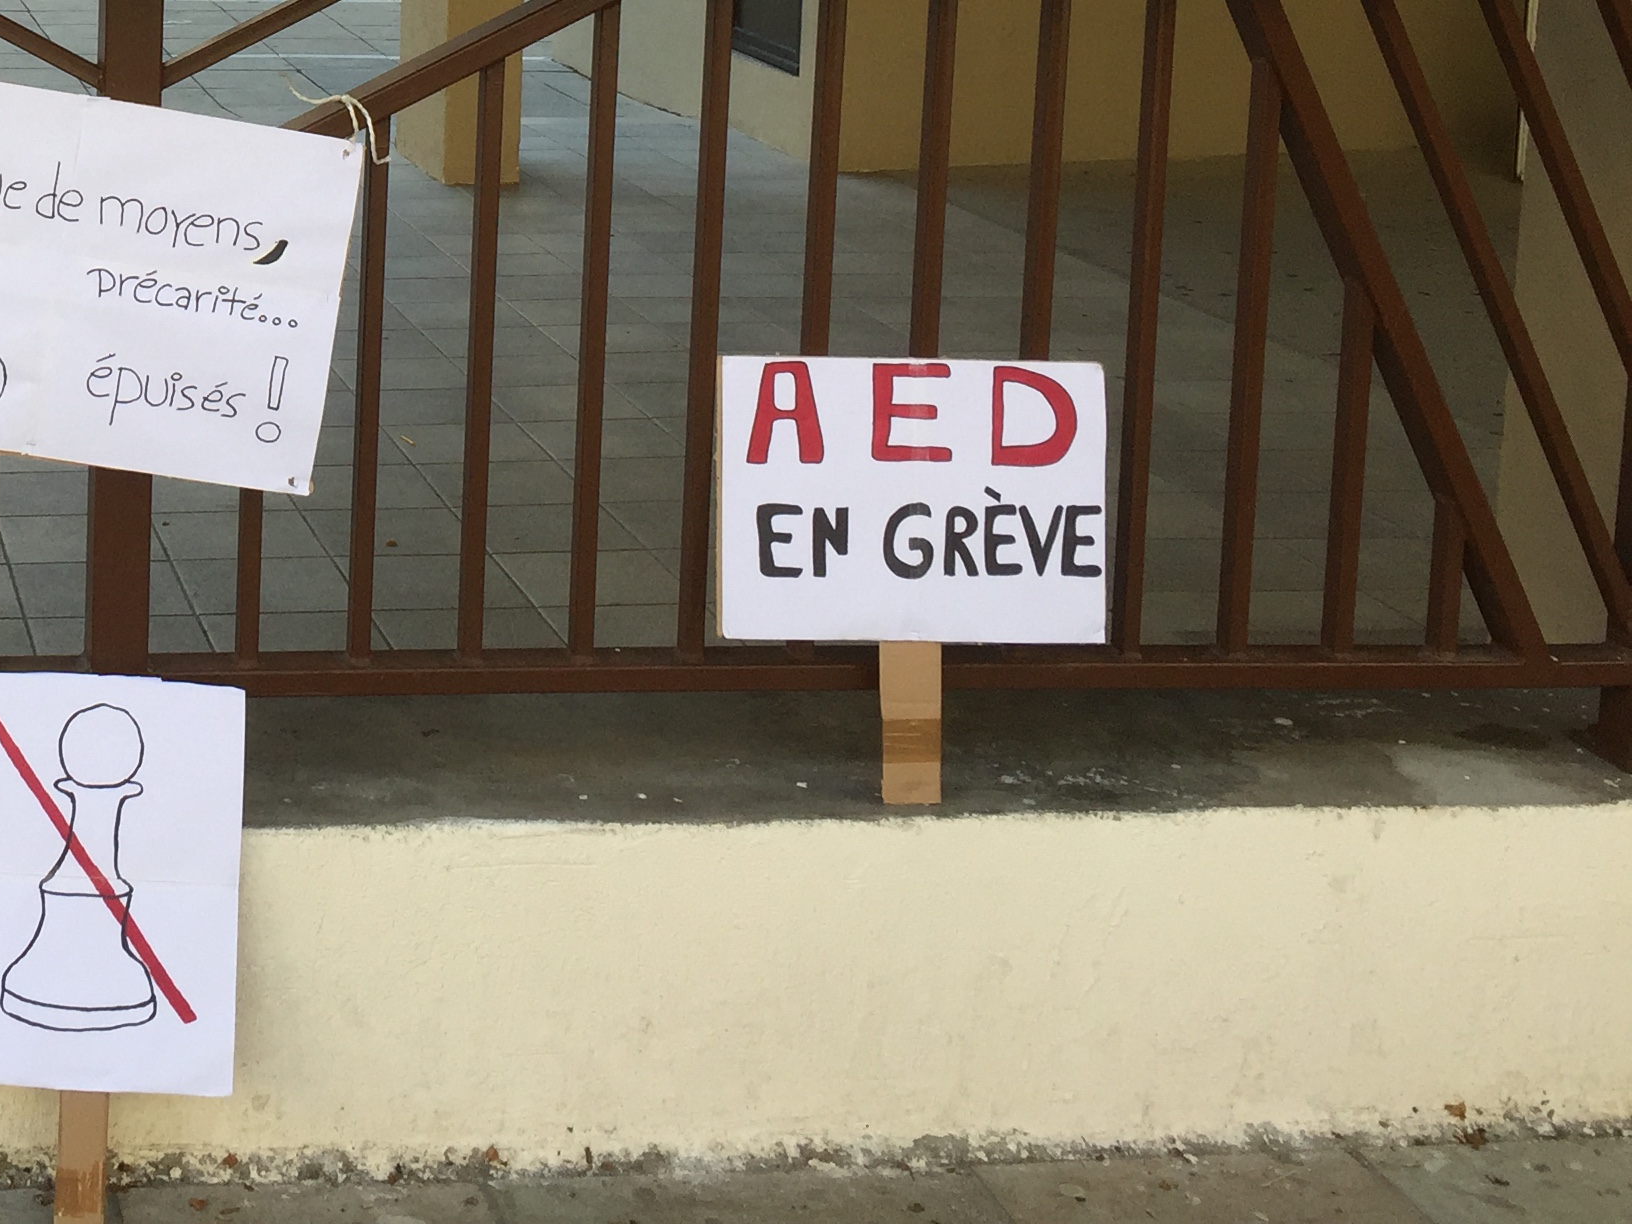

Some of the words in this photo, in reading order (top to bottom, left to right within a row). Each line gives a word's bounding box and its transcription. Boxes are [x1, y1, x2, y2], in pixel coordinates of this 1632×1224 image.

[35, 161, 84, 223] de
[99, 194, 289, 265] moyens,
[746, 360, 1078, 466] AED
[756, 502, 849, 578] EN
[883, 486, 1103, 579] GRÈVE
